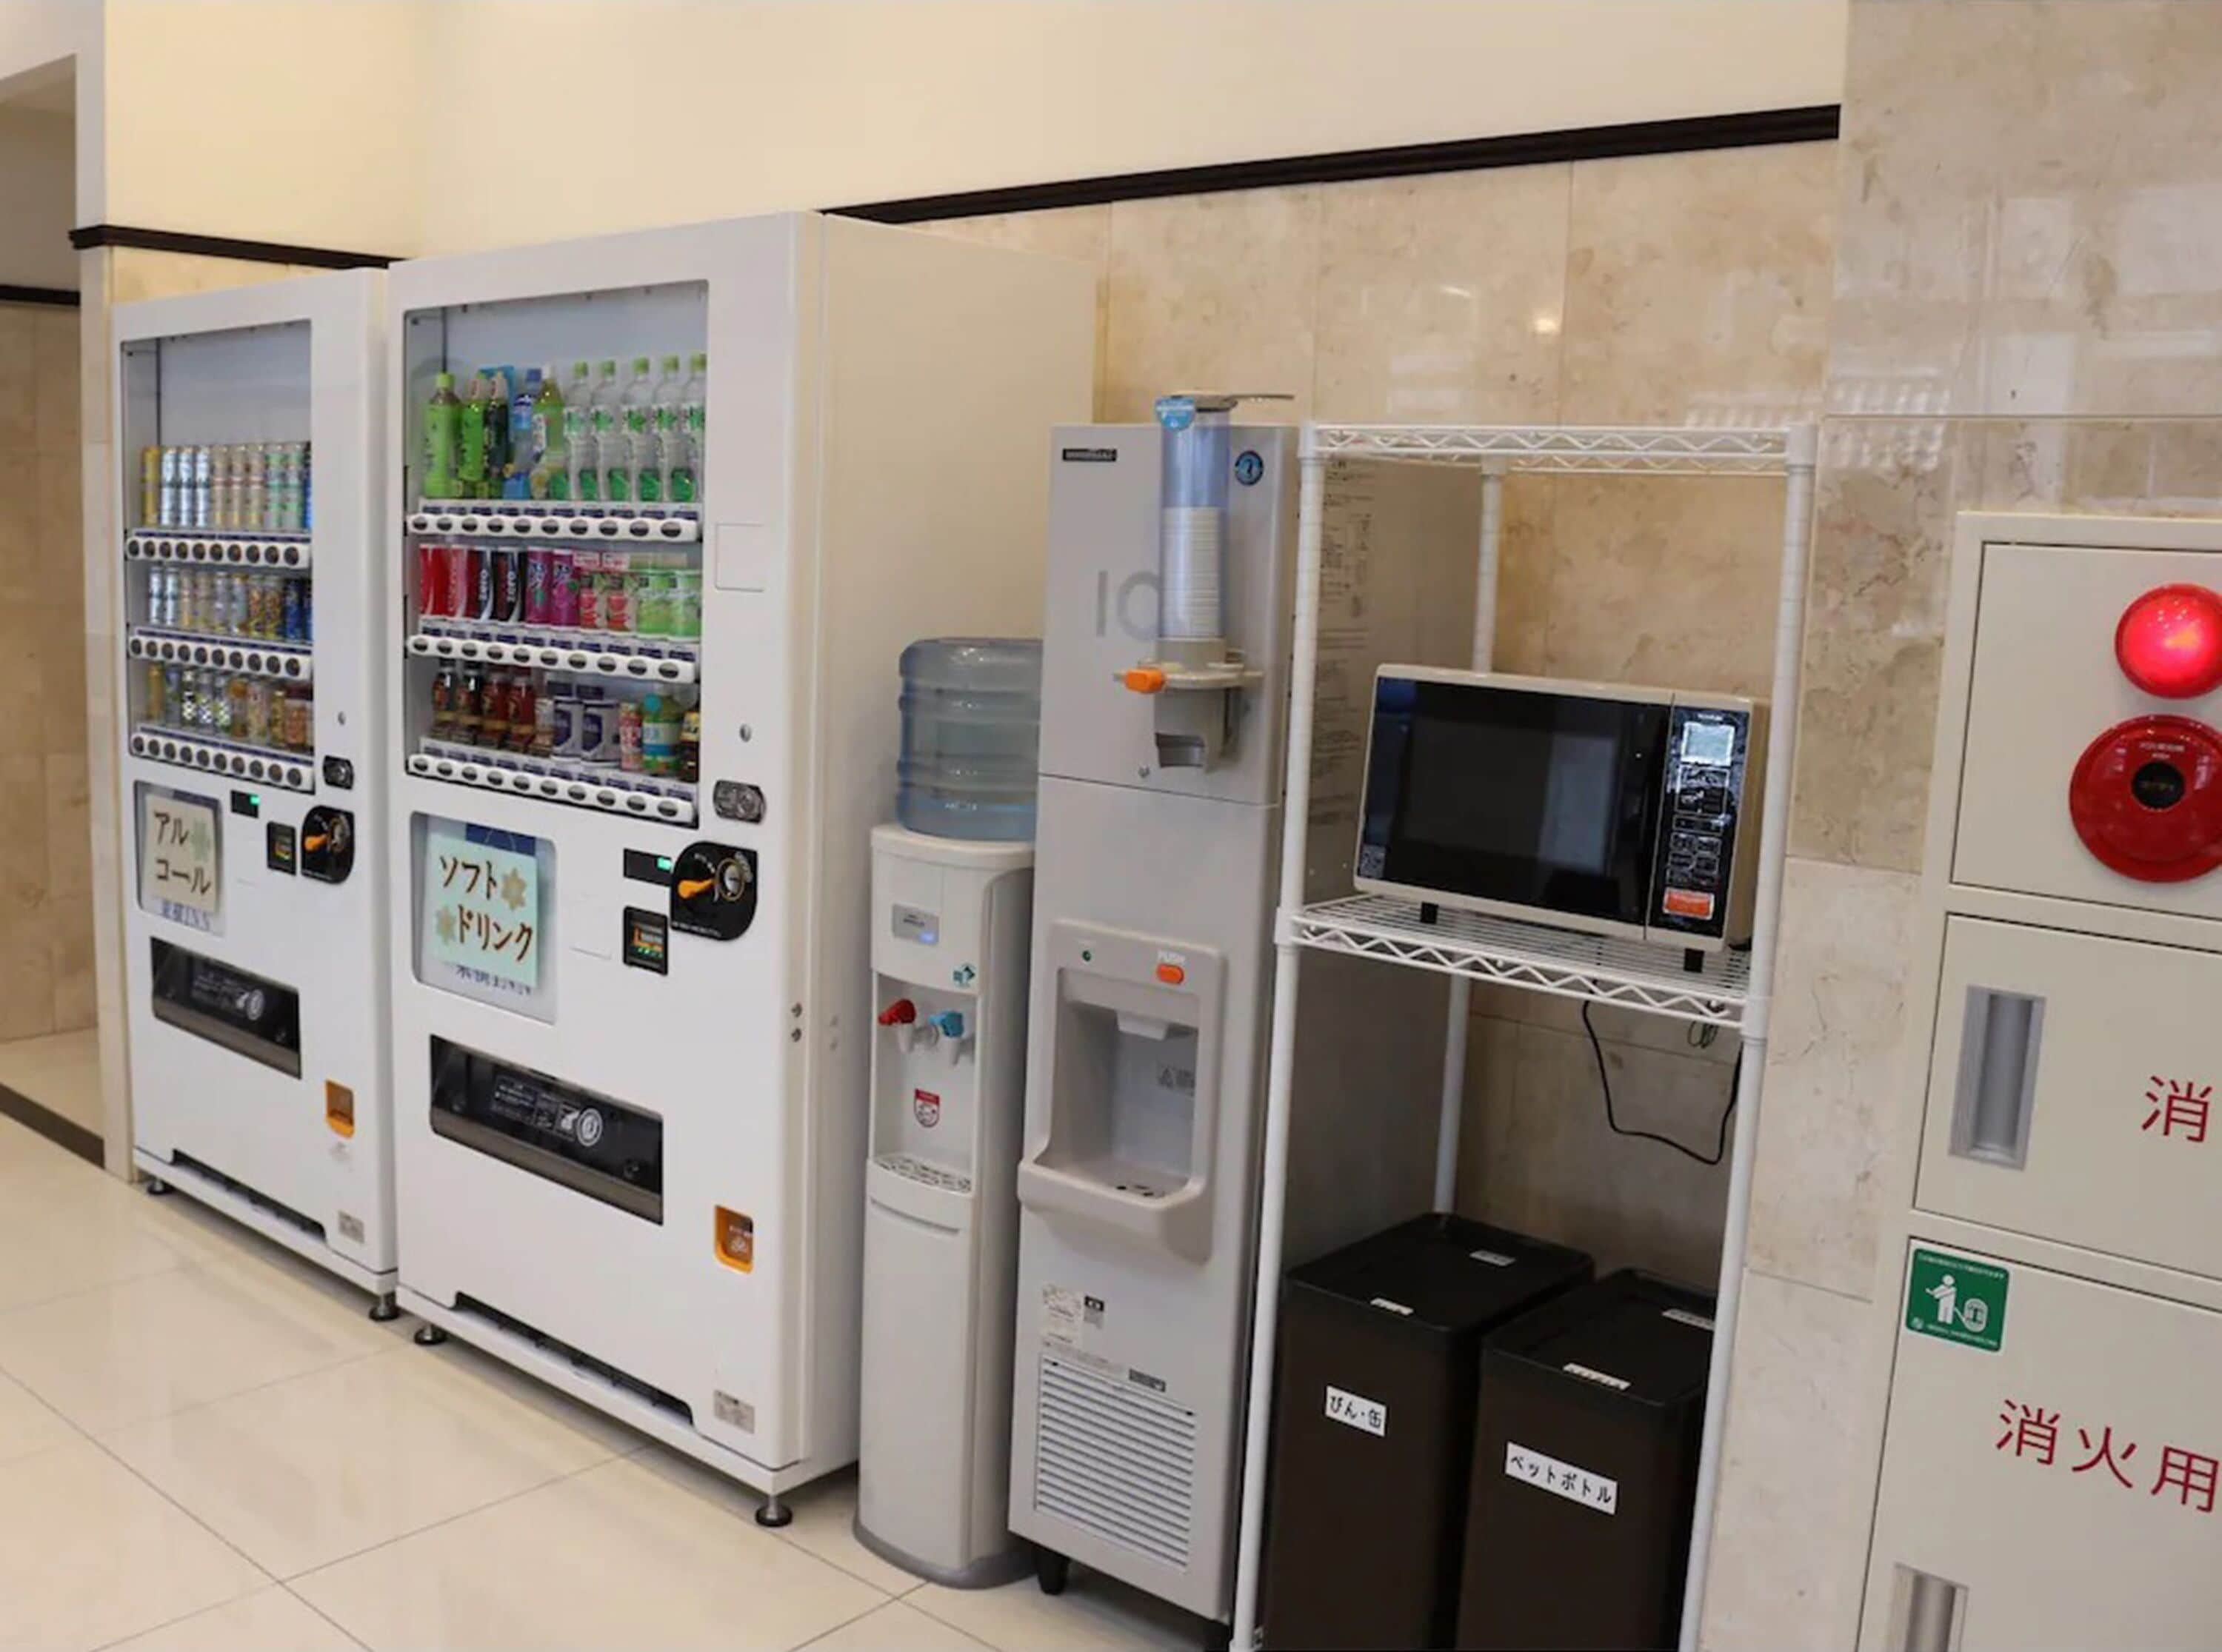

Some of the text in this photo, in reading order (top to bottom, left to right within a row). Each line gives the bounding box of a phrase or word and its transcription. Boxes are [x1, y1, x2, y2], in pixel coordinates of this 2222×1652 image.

[153, 811, 189, 846] アル
[156, 859, 211, 895] コール
[440, 855, 497, 901] ソフト
[458, 903, 533, 963] ドリンク
[2142, 1074, 2212, 1143] 消
[1995, 1399, 2220, 1513] 消火用
